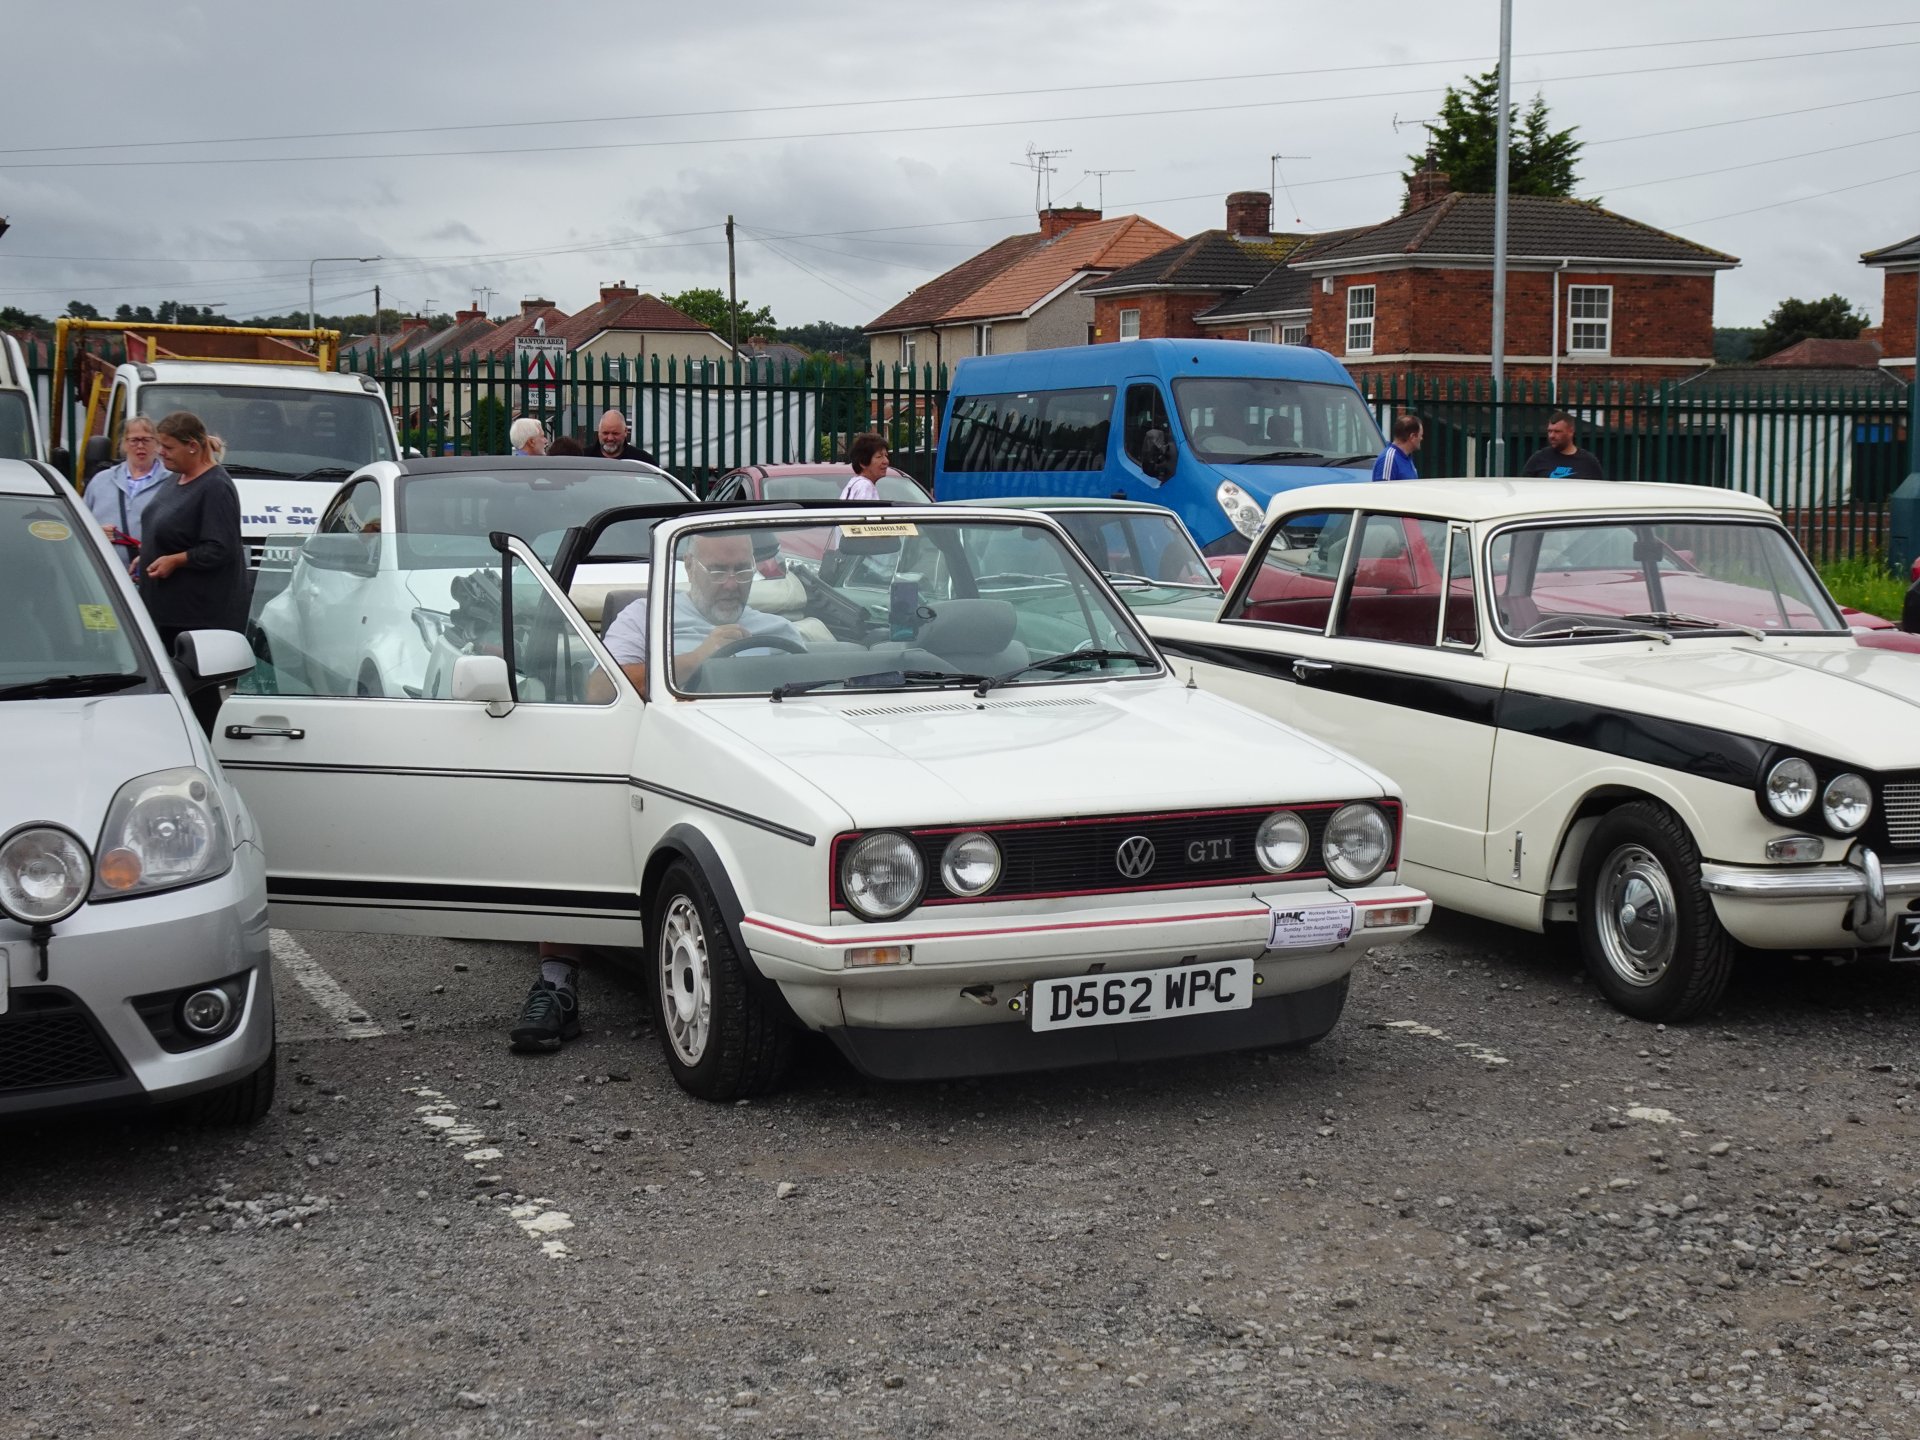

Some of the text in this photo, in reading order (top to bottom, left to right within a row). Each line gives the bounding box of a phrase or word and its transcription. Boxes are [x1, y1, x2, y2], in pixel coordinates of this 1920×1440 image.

[265, 505, 314, 514] K M
[241, 515, 319, 525] INI SK
[1188, 838, 1232, 862] GTI
[1050, 967, 1236, 1022] D562 WPC
